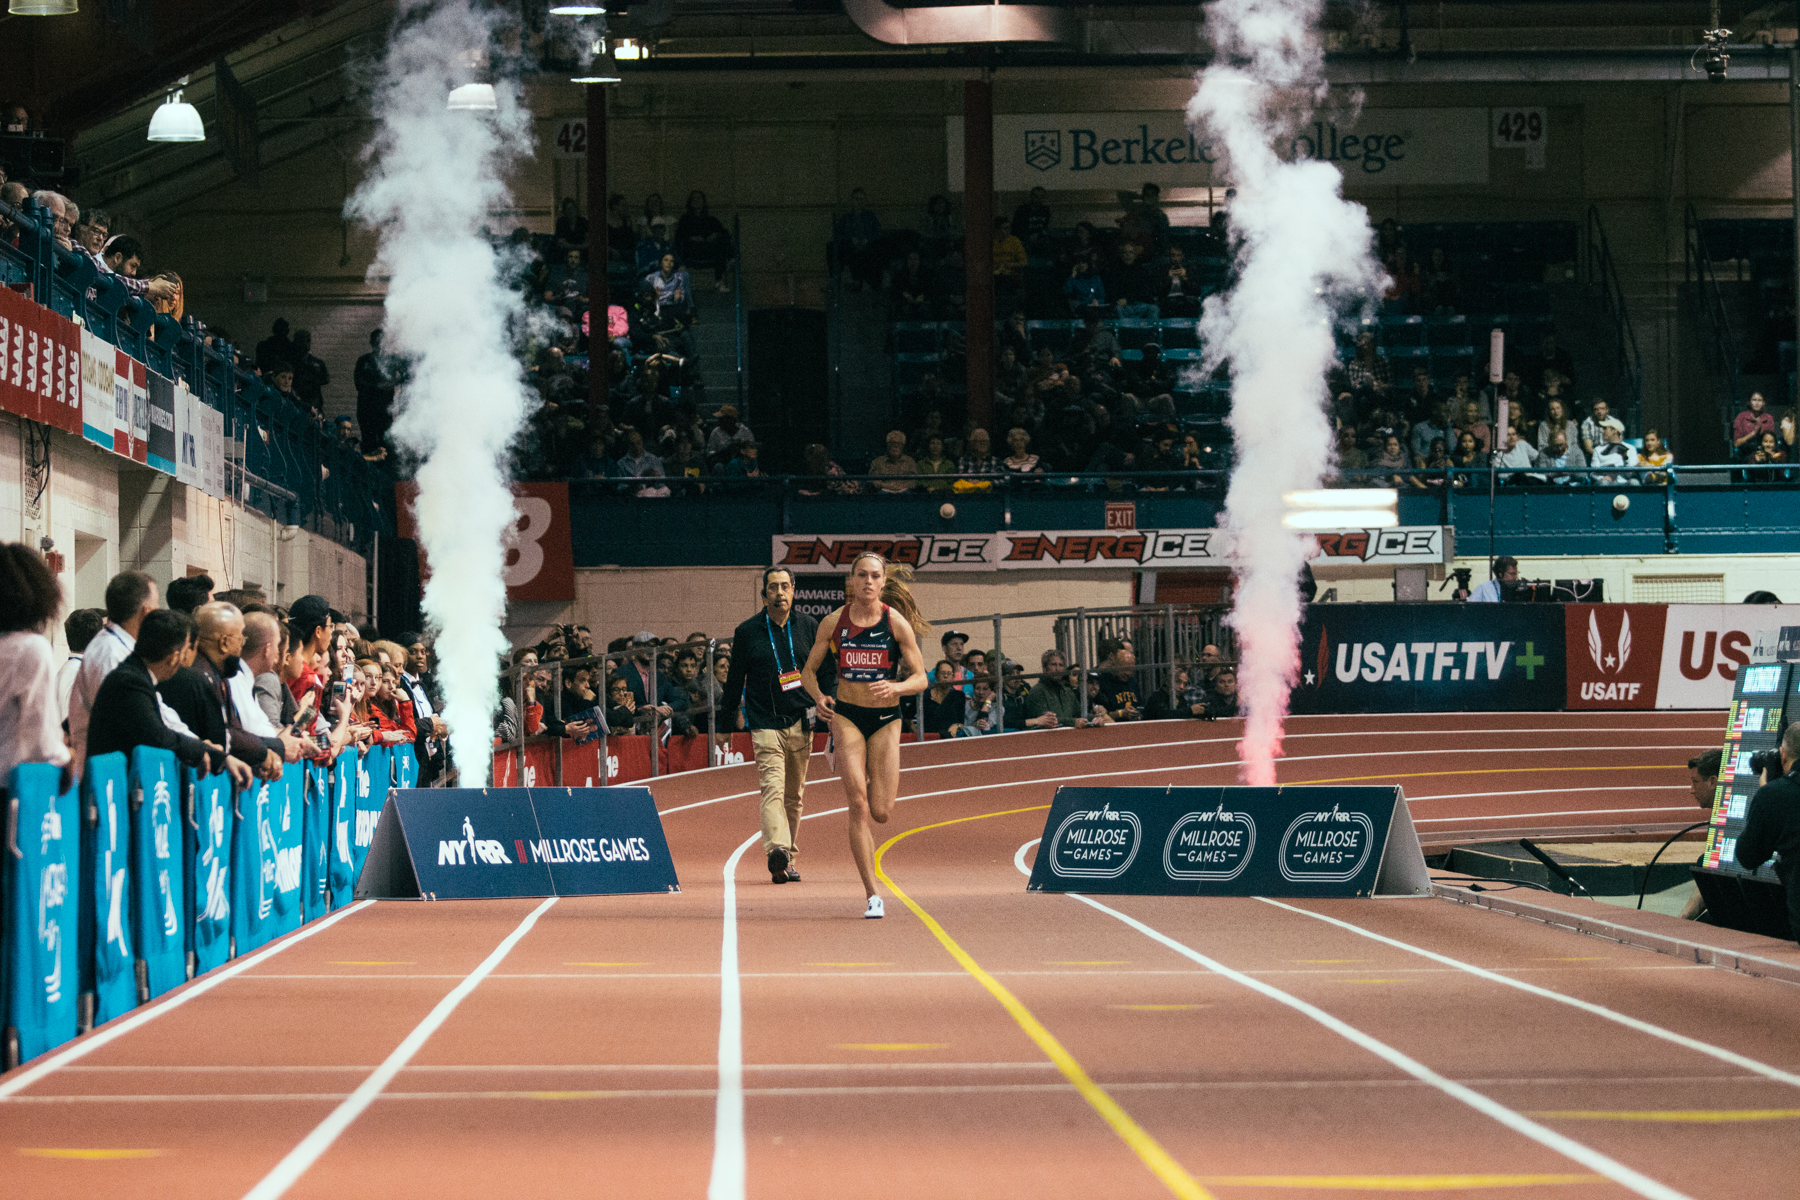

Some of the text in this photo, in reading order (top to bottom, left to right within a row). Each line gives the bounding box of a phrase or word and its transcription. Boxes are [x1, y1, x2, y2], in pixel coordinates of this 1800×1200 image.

[1498, 112, 1542, 142] 429
[557, 122, 587, 153] 42
[1069, 121, 1405, 173] Berkele ollege
[1107, 509, 1134, 528] EXIT
[1004, 530, 1212, 564] ENERGICE
[1314, 528, 1437, 562] RGICE
[793, 589, 845, 600] NAMAKER
[795, 604, 832, 615] ROOM
[845, 652, 883, 666] QUIGLEY
[1335, 640, 1510, 682] USATF.TV
[1679, 630, 1752, 681] US
[1580, 682, 1641, 701] USATF
[1066, 828, 1128, 845] MILLROSE
[1180, 829, 1242, 847] MILLROSE
[1295, 830, 1360, 848] MILLROSE
[437, 837, 651, 866] NYRR MILLROSE GAMES
[1074, 848, 1112, 861] GAMES
[1187, 851, 1227, 863] GAMES
[1303, 851, 1343, 864] GAMES
